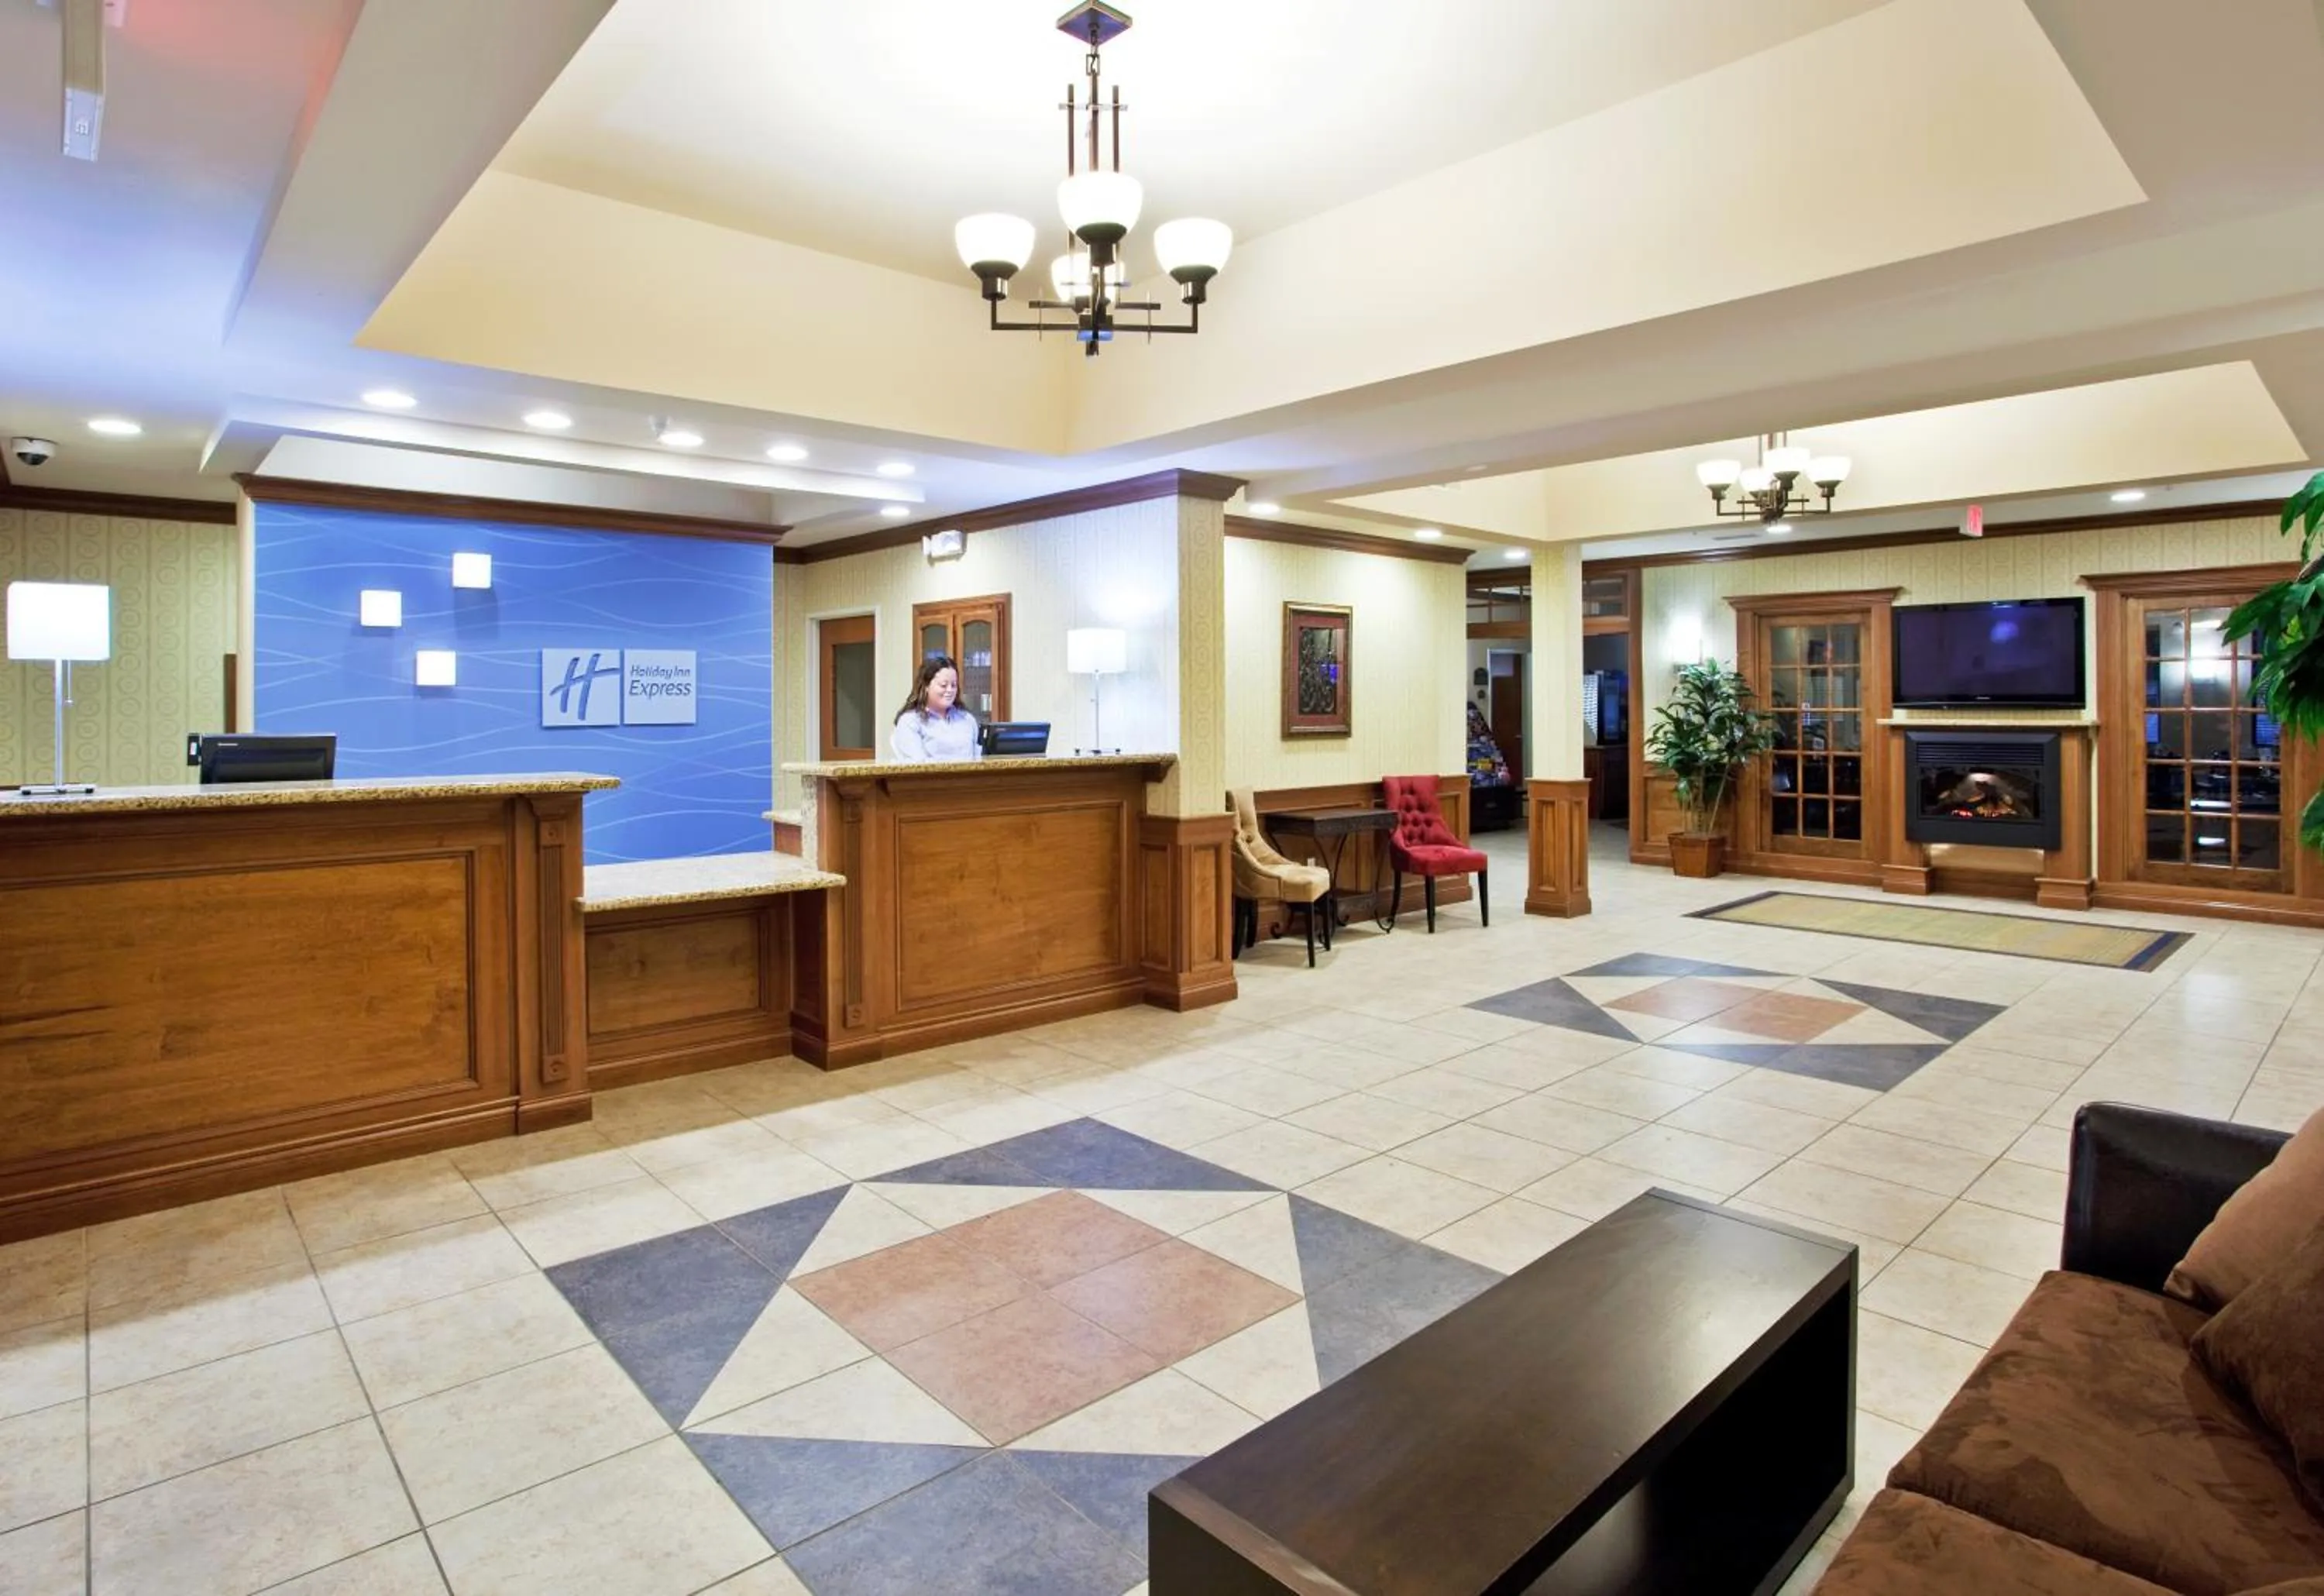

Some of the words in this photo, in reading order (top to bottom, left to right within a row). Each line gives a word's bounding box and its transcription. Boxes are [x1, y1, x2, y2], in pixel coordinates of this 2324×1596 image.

[631, 664, 672, 679] Holiday
[673, 666, 691, 676] Inn
[628, 679, 692, 699] Express
